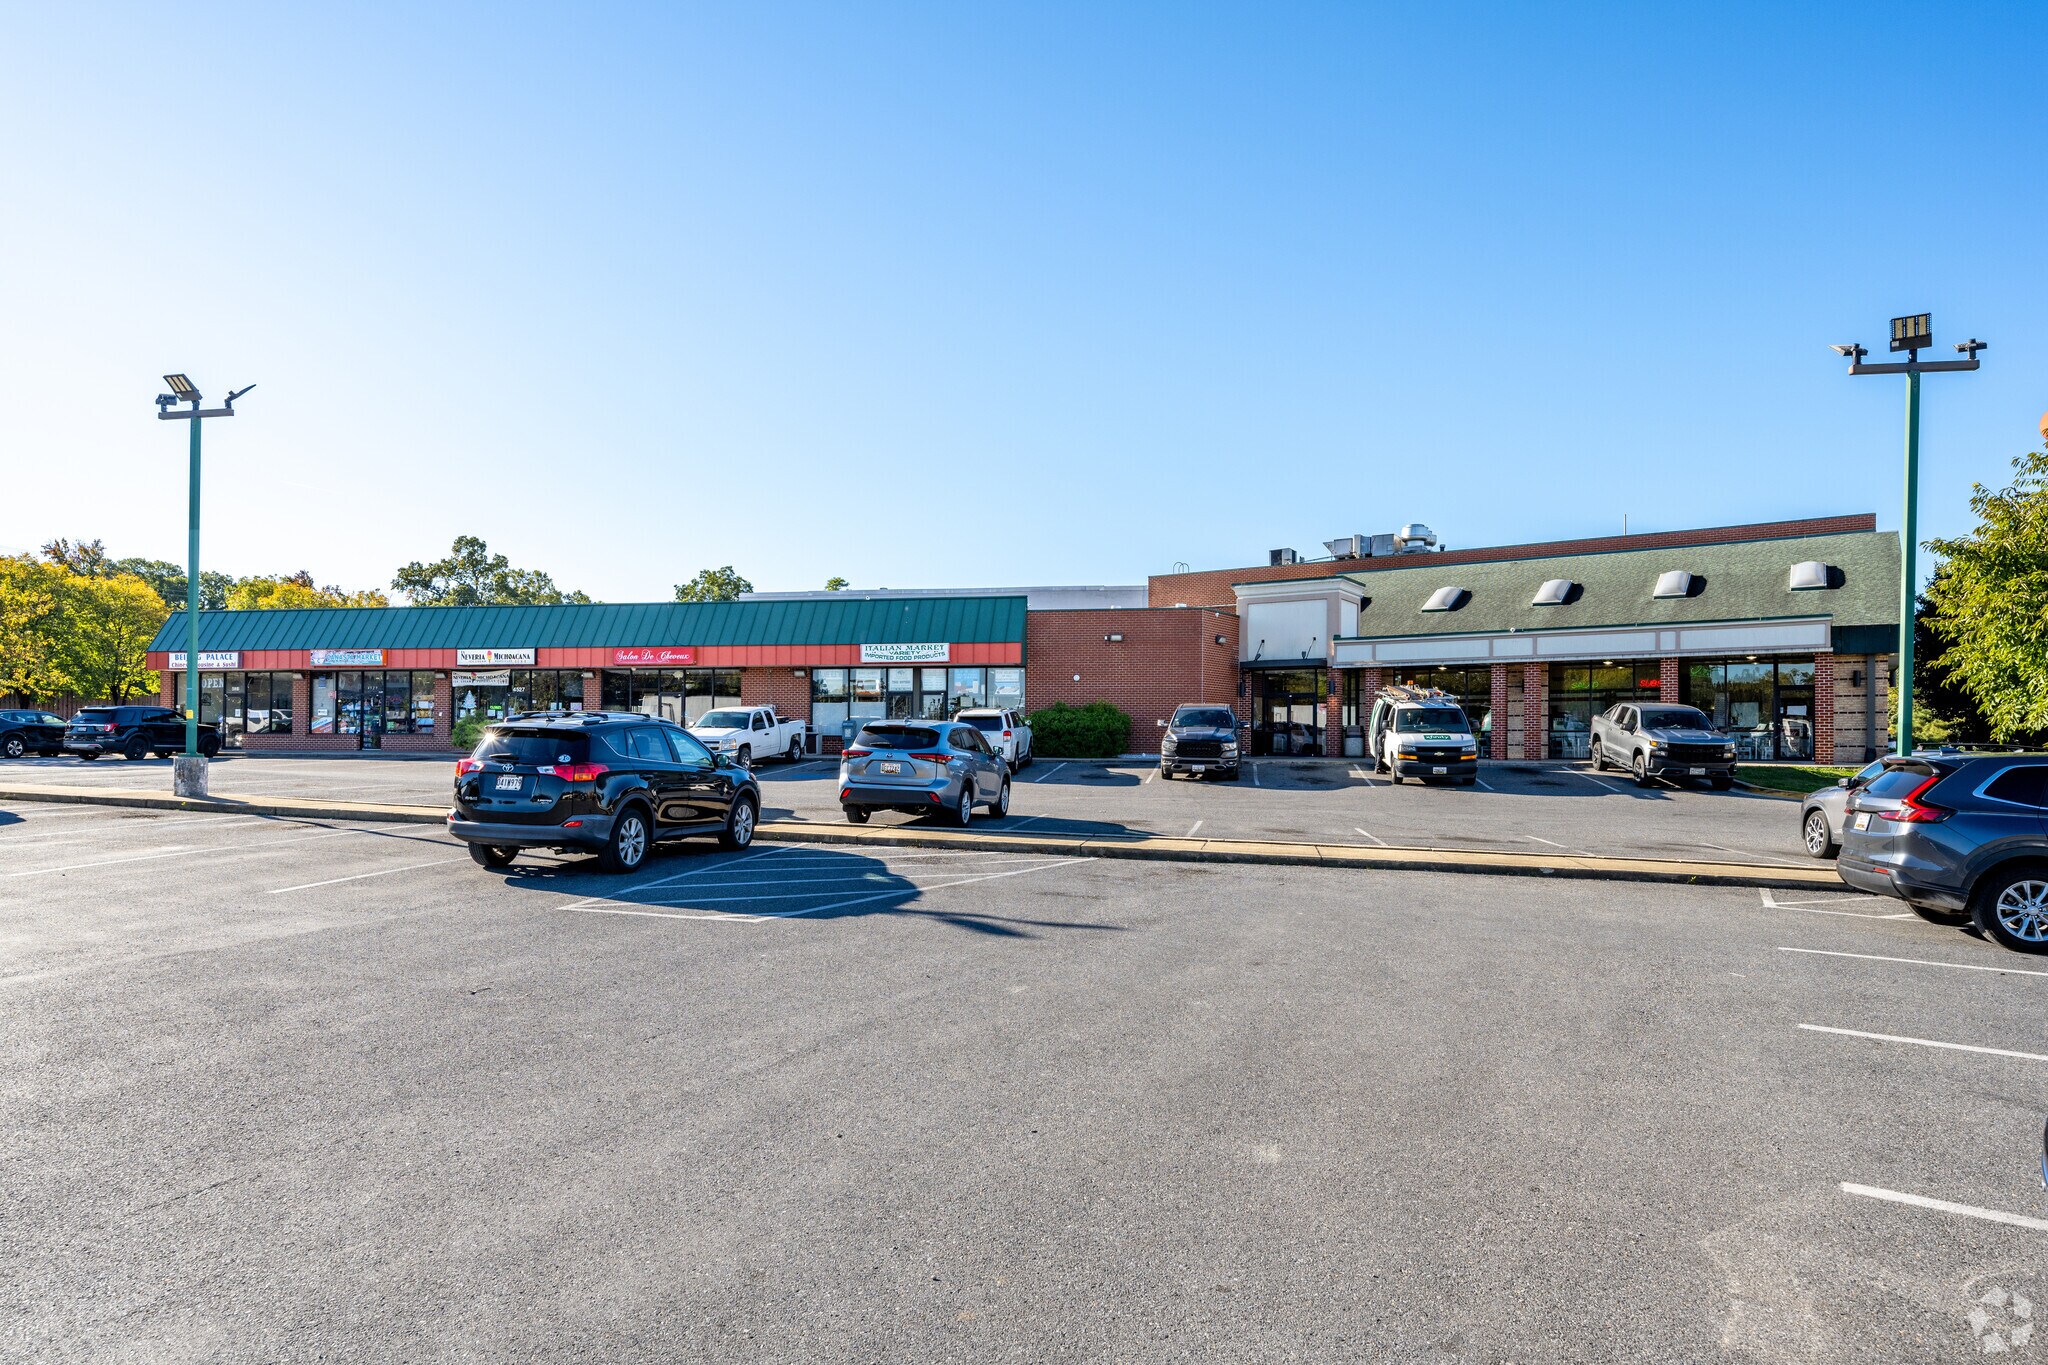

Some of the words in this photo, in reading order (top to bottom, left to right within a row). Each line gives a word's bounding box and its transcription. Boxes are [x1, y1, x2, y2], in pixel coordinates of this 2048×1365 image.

[617, 650, 639, 662] Salon
[641, 649, 654, 660] De
[656, 650, 690, 663] Cheveux
[864, 652, 895, 660] IMPORTED
[913, 651, 946, 660] PRODUCTS
[202, 678, 224, 688] OPEN
